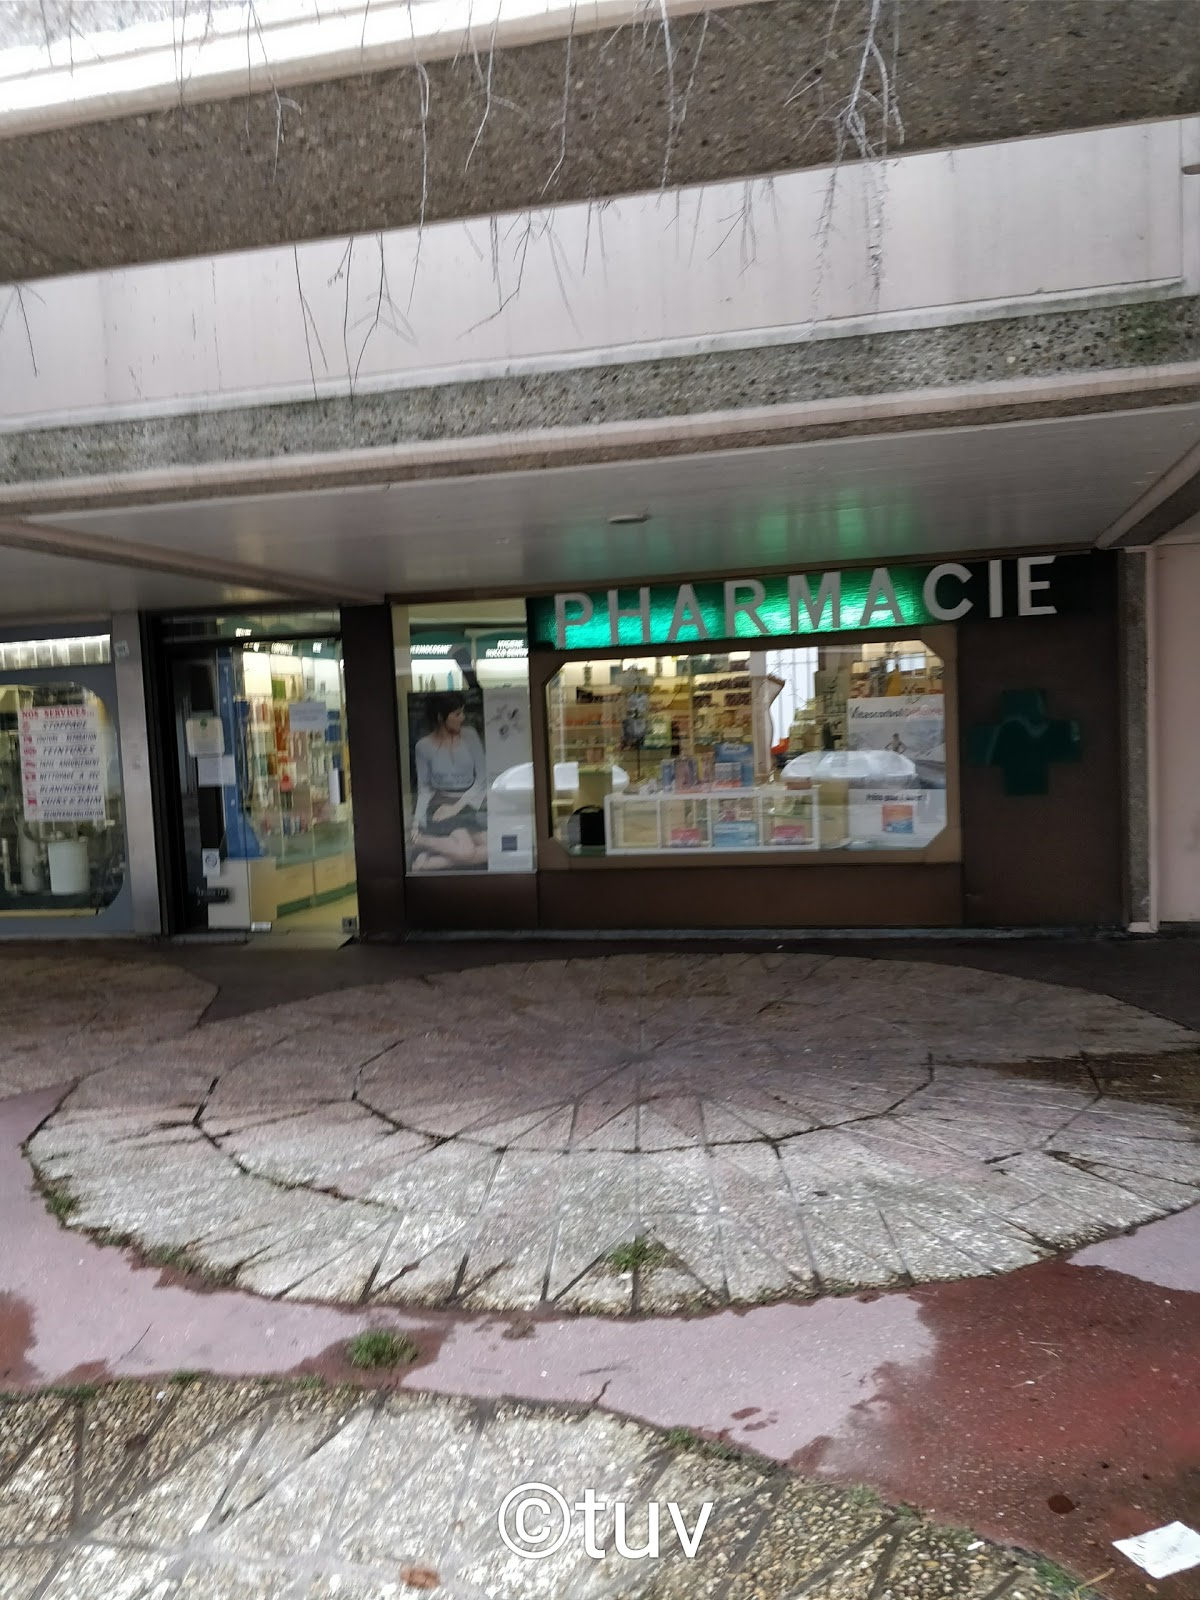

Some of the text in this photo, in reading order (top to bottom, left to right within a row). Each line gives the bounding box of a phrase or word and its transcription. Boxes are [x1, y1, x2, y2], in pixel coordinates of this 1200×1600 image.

[553, 555, 1058, 650] PHARMACIE
[22, 710, 39, 720] NOS
[43, 719, 87, 731] STOPPAGE
[43, 744, 95, 755] TEINTURES
